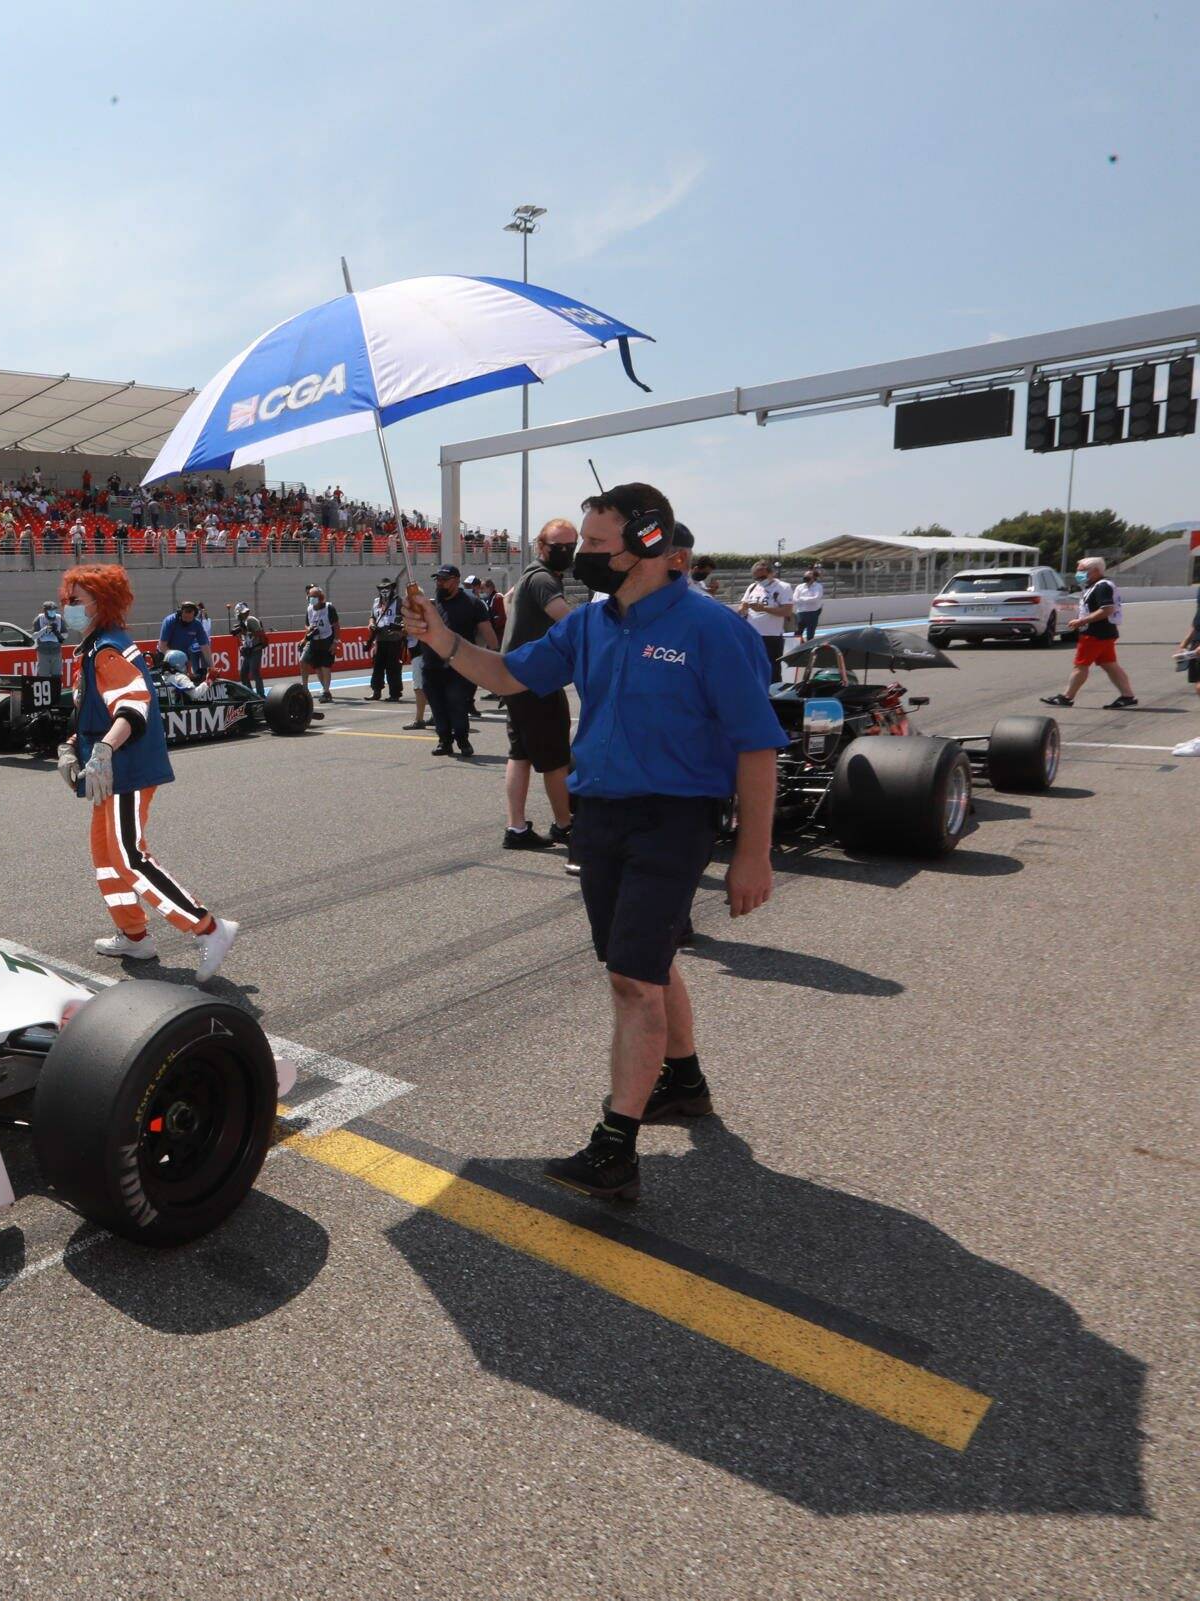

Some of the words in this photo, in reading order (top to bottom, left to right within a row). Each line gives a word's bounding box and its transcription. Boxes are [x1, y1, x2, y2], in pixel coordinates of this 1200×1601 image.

[259, 363, 347, 421] CGA
[653, 647, 686, 666] CGA
[33, 681, 52, 707] 99
[161, 705, 226, 738] NIM
